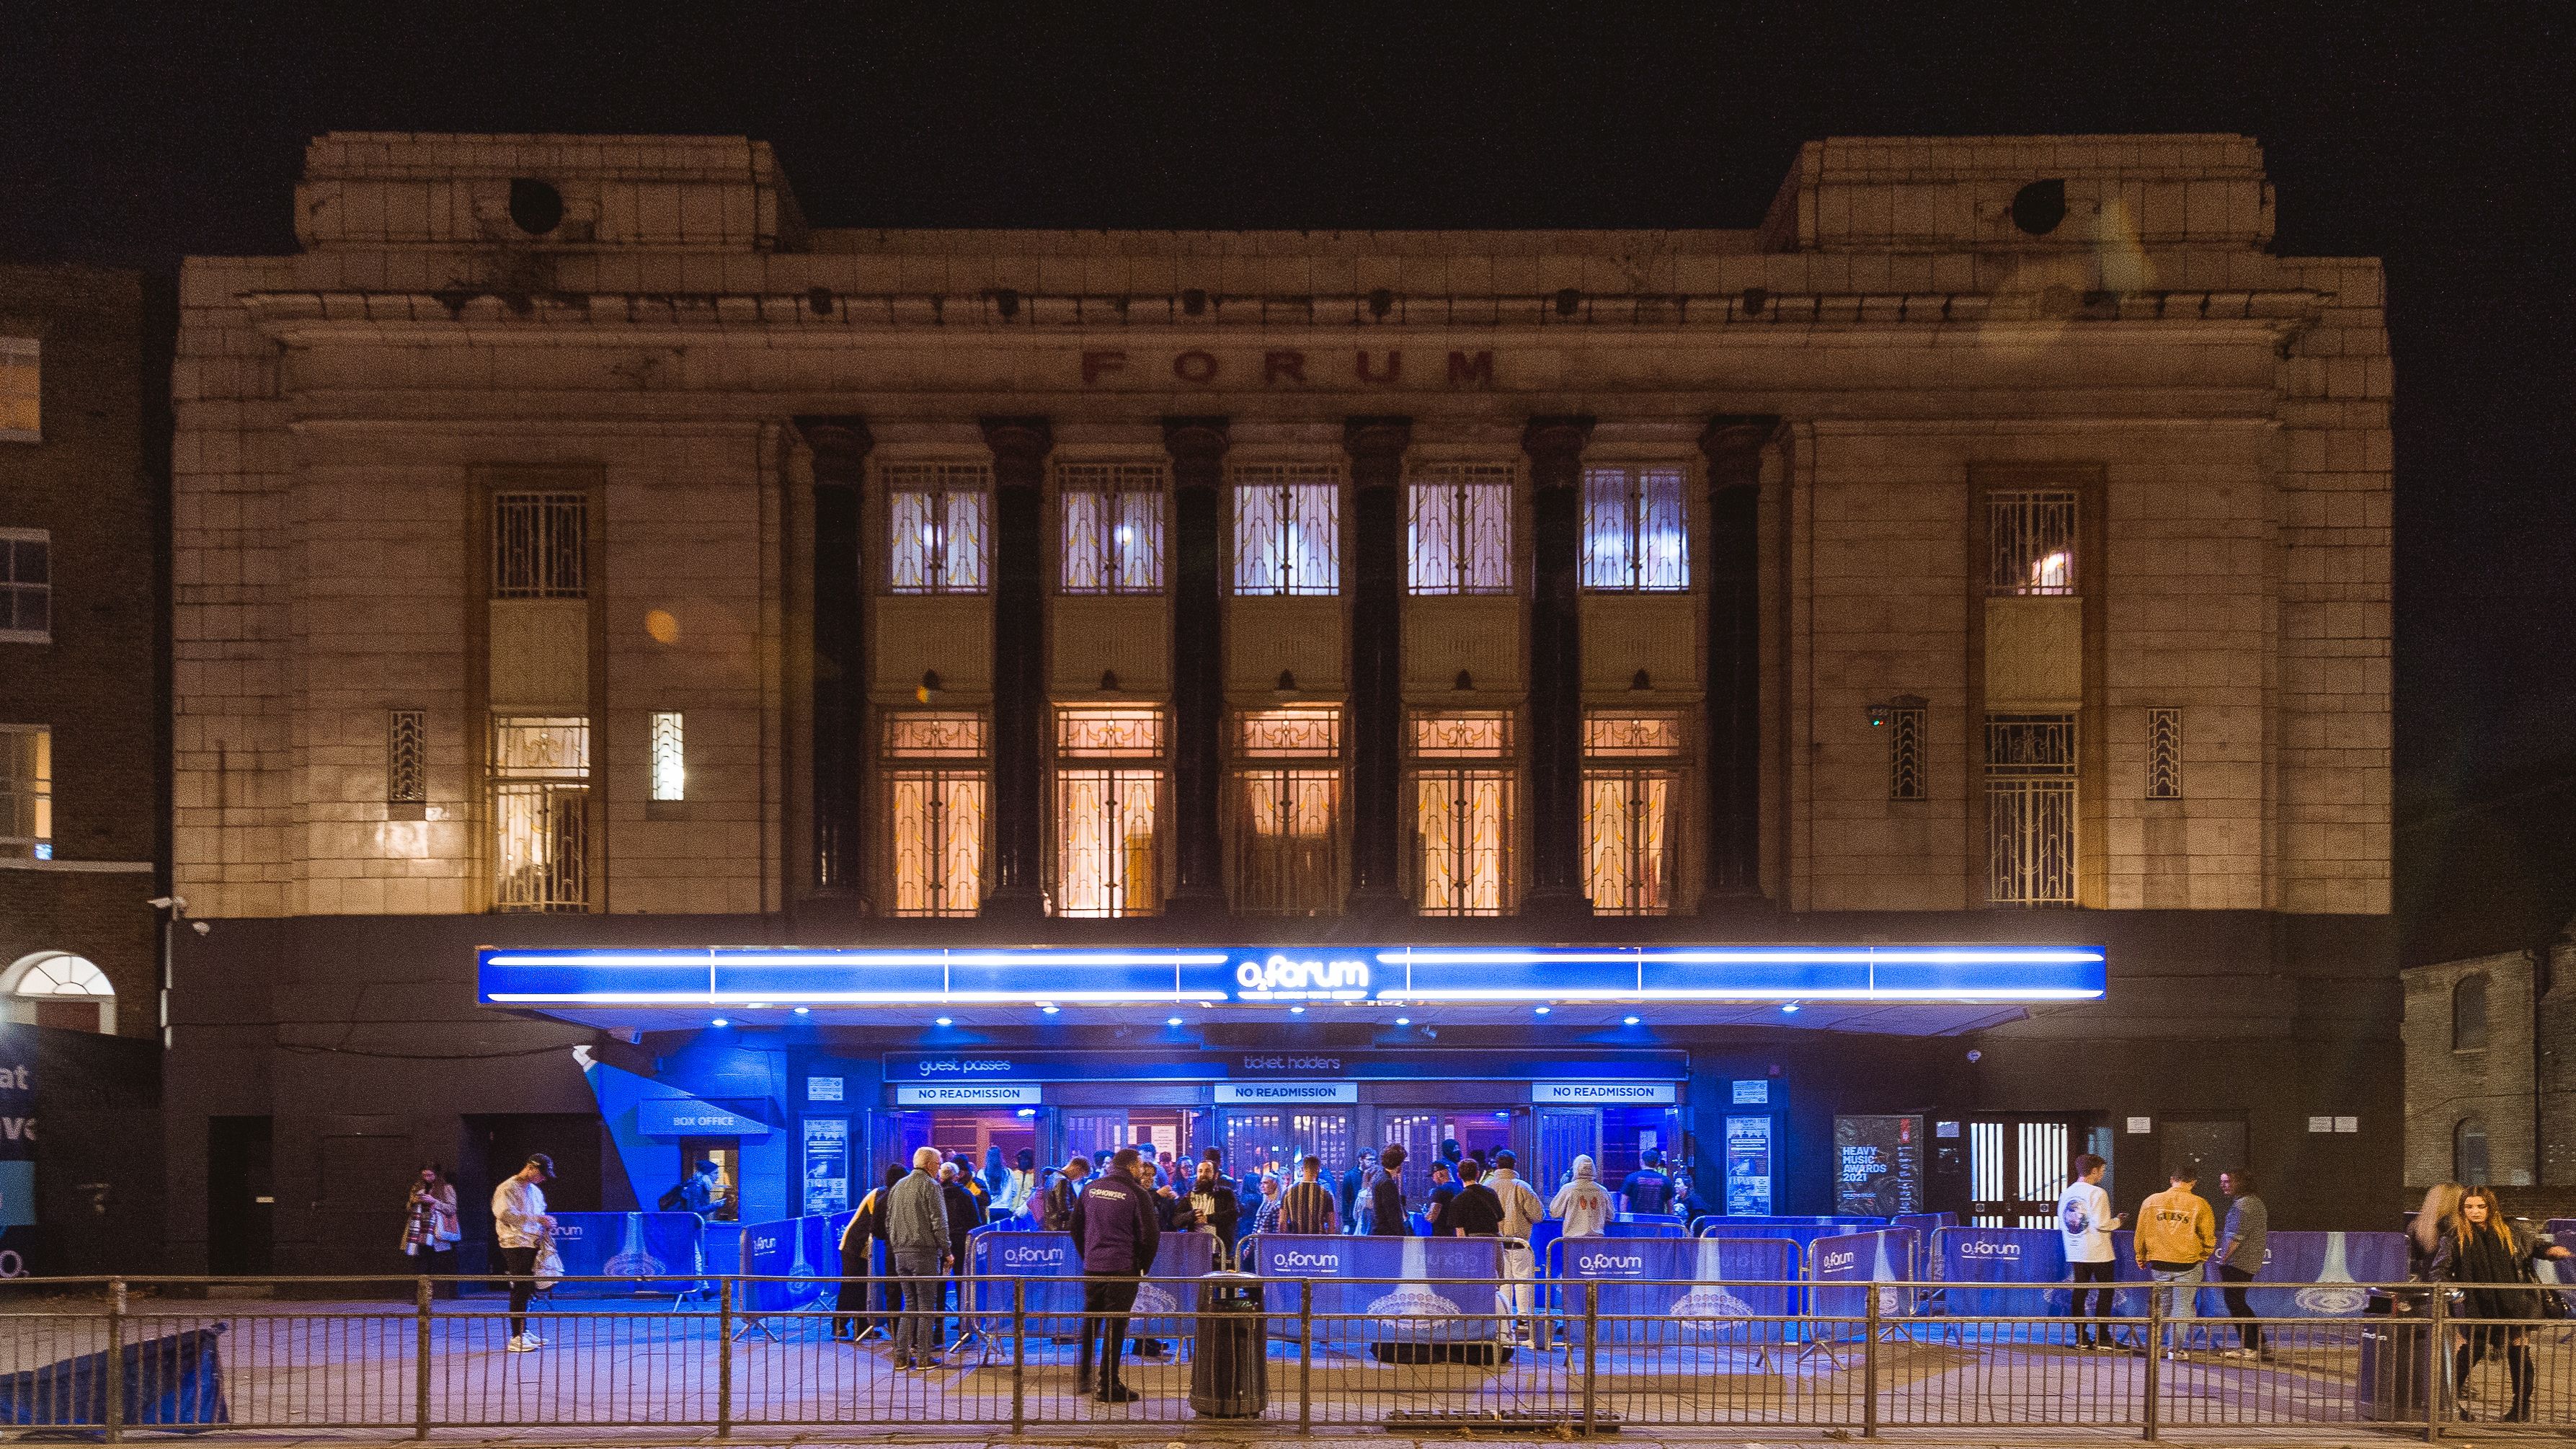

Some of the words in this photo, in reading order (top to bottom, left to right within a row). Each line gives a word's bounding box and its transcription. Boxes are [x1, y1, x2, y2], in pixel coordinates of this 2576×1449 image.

[1083, 350, 1494, 384] FORUM
[919, 1058, 961, 1076] guest
[964, 1060, 1011, 1073] passes
[1244, 1055, 1285, 1069] ticket
[1288, 1055, 1340, 1069] holders
[918, 1089, 936, 1099] NO
[940, 1089, 1021, 1099] READMISSION
[1235, 1088, 1253, 1097] NO
[1256, 1088, 1336, 1097] READMISSION
[1553, 1087, 1571, 1096] NO
[1574, 1087, 1654, 1096] READMISSION
[673, 1117, 696, 1126] BOX
[698, 1117, 734, 1126] OFFICE
[1842, 1146, 1878, 1156] HEAVY
[1842, 1156, 1875, 1164] MUSIC
[1843, 1164, 1887, 1173] AWARDS
[1842, 1173, 1868, 1182] 2021
[1095, 1189, 1127, 1200] SHOWSEC
[2157, 1213, 2189, 1224] GUESS
